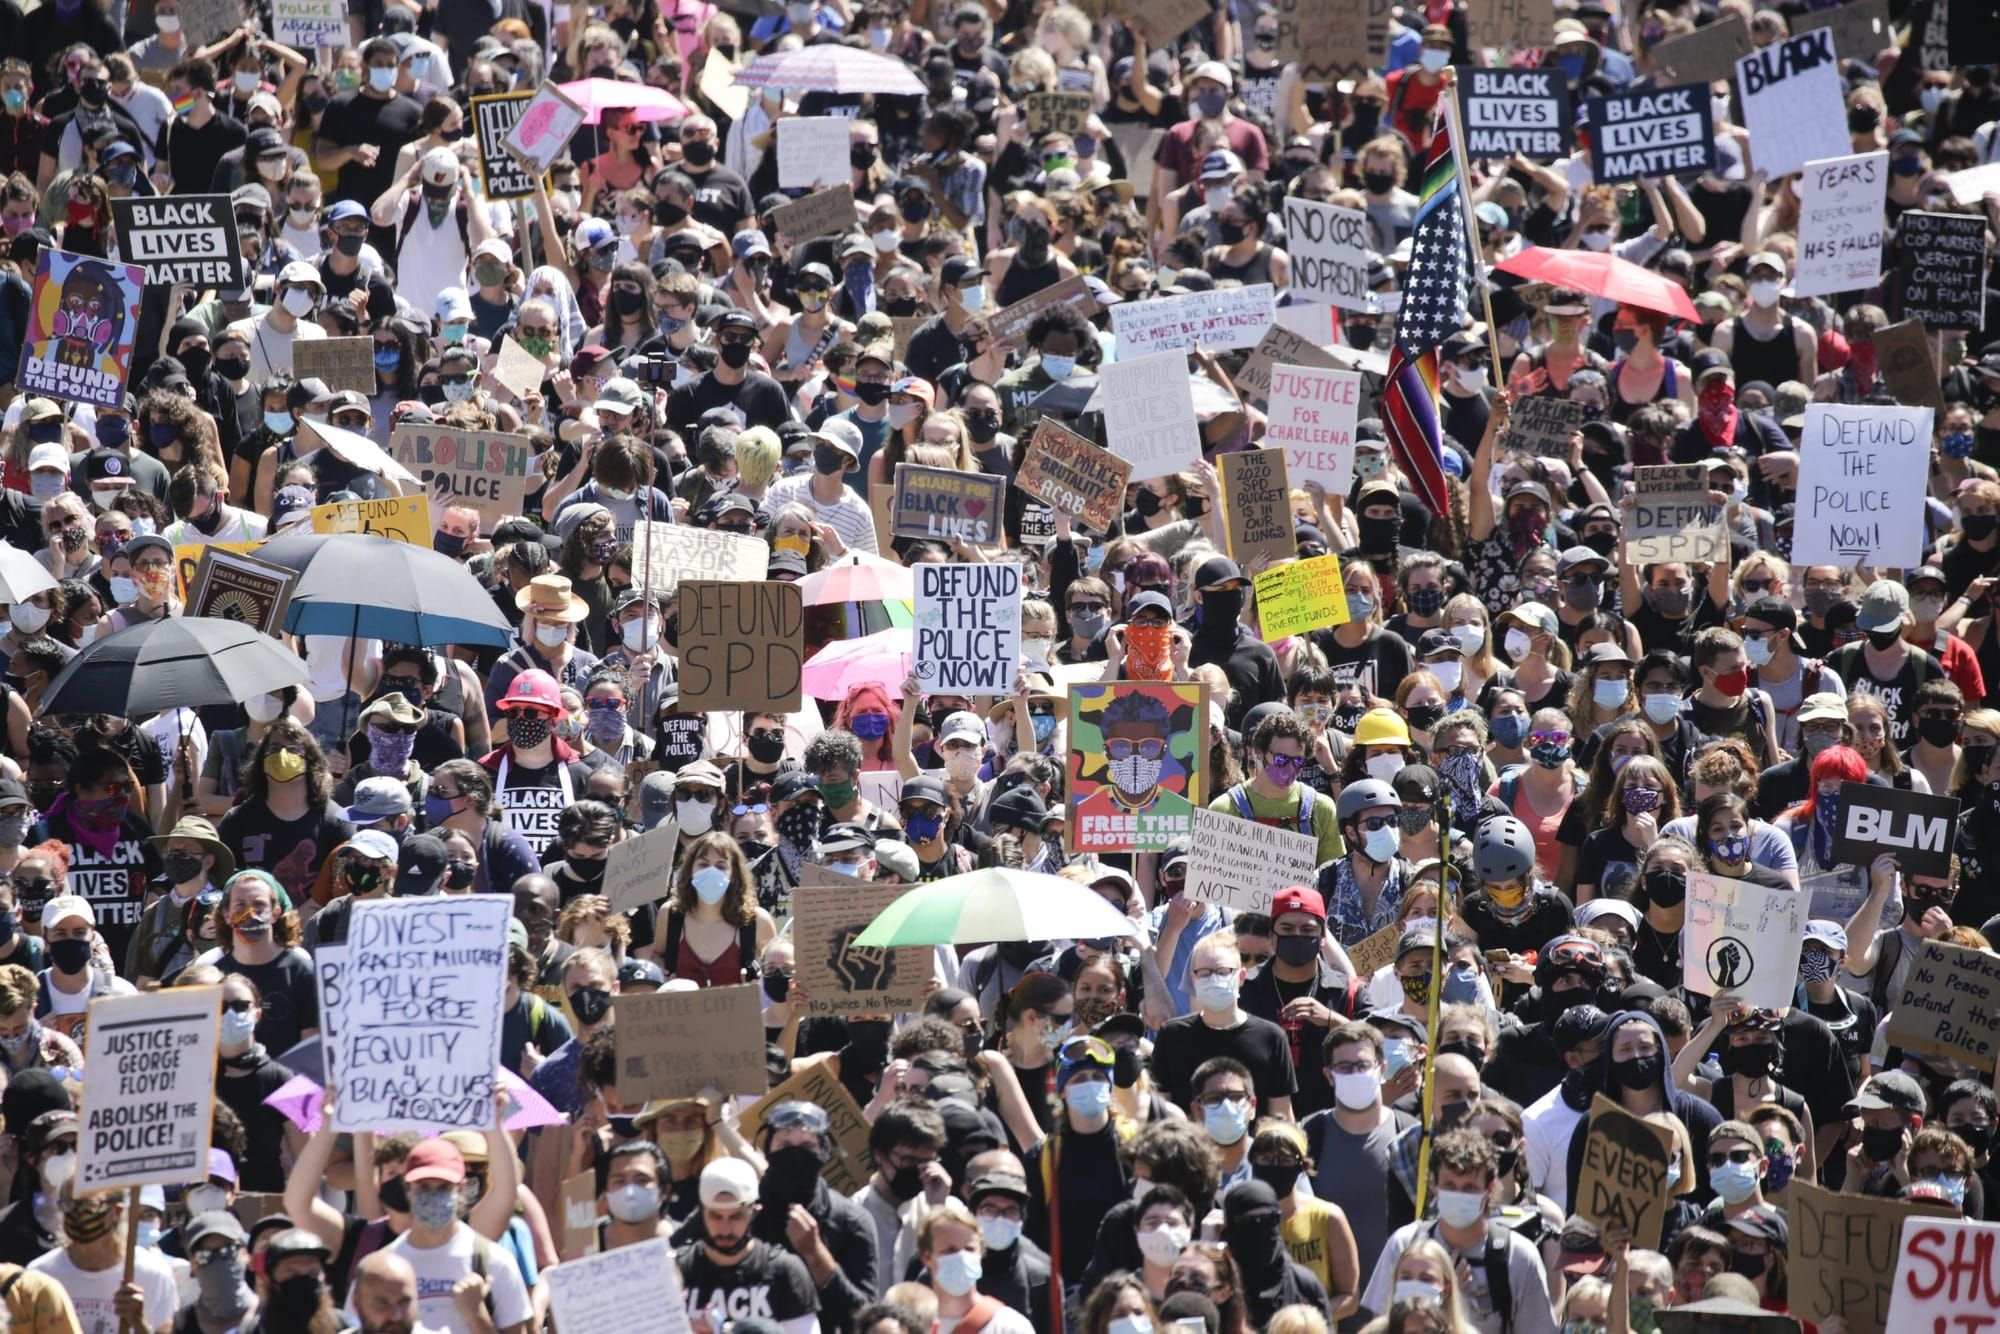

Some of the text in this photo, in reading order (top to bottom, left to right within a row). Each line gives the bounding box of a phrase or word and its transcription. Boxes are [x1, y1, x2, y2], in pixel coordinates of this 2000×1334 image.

[281, 20, 342, 33] ABOLISH
[295, 31, 327, 46] ICE
[1742, 31, 1834, 96] BLACK
[1473, 74, 1550, 96] BLACK
[1029, 95, 1091, 113] DEFUND
[1480, 104, 1547, 122] LIVES
[1605, 91, 1692, 122] BLACK
[1041, 111, 1079, 132] SPD
[1613, 120, 1689, 148] LIVES
[1469, 131, 1562, 152] MATTER
[1603, 145, 1706, 178] MATTER
[1816, 160, 1876, 191] YEARS
[131, 203, 216, 226] BLACK
[1906, 215, 1940, 232] HOW
[1287, 205, 1367, 252] NO COPS
[141, 232, 216, 256] LIVES
[1804, 240, 1836, 260] HAS
[1904, 232, 1986, 253] COP MURDERS
[1291, 254, 1318, 291] NO
[1914, 251, 1977, 268] WEREN'T
[143, 262, 233, 286] MATTER
[1912, 266, 1977, 287] CAUGHT
[1906, 286, 1928, 301] ON
[1184, 309, 1202, 322] BE
[1126, 320, 1198, 344] WE MUST BE
[1203, 330, 1236, 345] DAVIS
[1266, 326, 1302, 355] I'M
[26, 357, 121, 391] DEFUND
[25, 372, 117, 405] THE POLICE
[1272, 372, 1357, 406] JUSTICE
[1109, 391, 1182, 432] LIVES
[1292, 407, 1320, 425] FOR
[1267, 424, 1350, 447] CHARLEENA
[1520, 416, 1567, 435] MATTER
[1822, 412, 1916, 447] DEFUND
[399, 435, 529, 478] ABOLISH
[1040, 434, 1073, 461] STOP
[1240, 453, 1268, 467] THE
[1070, 449, 1122, 490] POLICE
[1235, 466, 1272, 482] 2020
[1640, 468, 1682, 484] BLACK
[1838, 450, 1876, 476] THE
[420, 468, 502, 500] POLICE
[906, 474, 994, 499] ASIANS FOR
[1039, 456, 1105, 501] BRUTALITY
[1242, 480, 1268, 492] SPD
[1636, 483, 1669, 494] LIVES
[904, 491, 959, 516] BLACK
[1039, 480, 1086, 514] ACAB
[1236, 488, 1285, 508] BUDGET
[1813, 485, 1890, 518] POLICE
[336, 499, 400, 524] DEFUND
[1241, 504, 1273, 518] IS IN
[927, 513, 989, 543] LIVES
[1021, 523, 1041, 536] THE
[1242, 529, 1286, 544] LUNGS
[1245, 517, 1275, 533] OUR
[1829, 522, 1879, 551] NOW!
[1636, 534, 1716, 559] SPD
[640, 546, 738, 576] MAYOR
[1285, 558, 1329, 577] SCHOOLS
[214, 567, 277, 593] SOUTH ASIANS FOR
[922, 566, 1018, 598] DEFUND
[1299, 583, 1341, 603] SERVICES
[678, 584, 803, 638] DEFUND
[935, 597, 997, 630] THE
[1265, 606, 1299, 623] Defund
[1267, 604, 1339, 633] DIVERT FUNDS
[917, 629, 1012, 662] POLICE
[681, 642, 802, 699] SPD
[938, 660, 1007, 690] NOW!
[663, 719, 699, 733] DEFUND
[672, 732, 690, 743] THE
[665, 743, 698, 757] POLICE
[501, 790, 564, 808] BLACK
[511, 812, 561, 832] IVES
[1081, 815, 1189, 833] FREE THE
[1193, 809, 1317, 858] HOUSING, HEALTHCARE
[1844, 804, 1949, 852] BLM
[1190, 844, 1292, 880] AND NEIGHBORS CARE
[1221, 838, 1269, 864] FINANCIAL
[1189, 860, 1261, 889] COMMUNITIES
[1196, 880, 1241, 905] NOT
[359, 912, 471, 946] DIVEST
[1925, 945, 2000, 980] No Justice
[357, 974, 460, 1004] POLICE
[1915, 967, 1991, 1000] No Peace
[380, 998, 477, 1021] FORCE
[624, 991, 738, 1021] SEATTLE CITY
[810, 996, 913, 1012] No No Peace
[1902, 990, 2000, 1032] Defund the
[103, 1029, 198, 1056] JUSTICE FOR
[350, 1029, 462, 1067] EQUITY
[1934, 1019, 1991, 1056] Police
[117, 1050, 181, 1077] GEORGE
[651, 1051, 709, 1078] PROVE
[119, 1070, 176, 1096] FLOYD!
[350, 1074, 491, 1103] BLACK LIVES
[88, 1102, 198, 1132] ABOLISH THE
[802, 1073, 863, 1138] INVEST
[93, 1122, 175, 1154] POLICE!
[1587, 1136, 1669, 1201] EVERY
[1591, 1179, 1650, 1238] DAY
[688, 1285, 774, 1321] LACK
